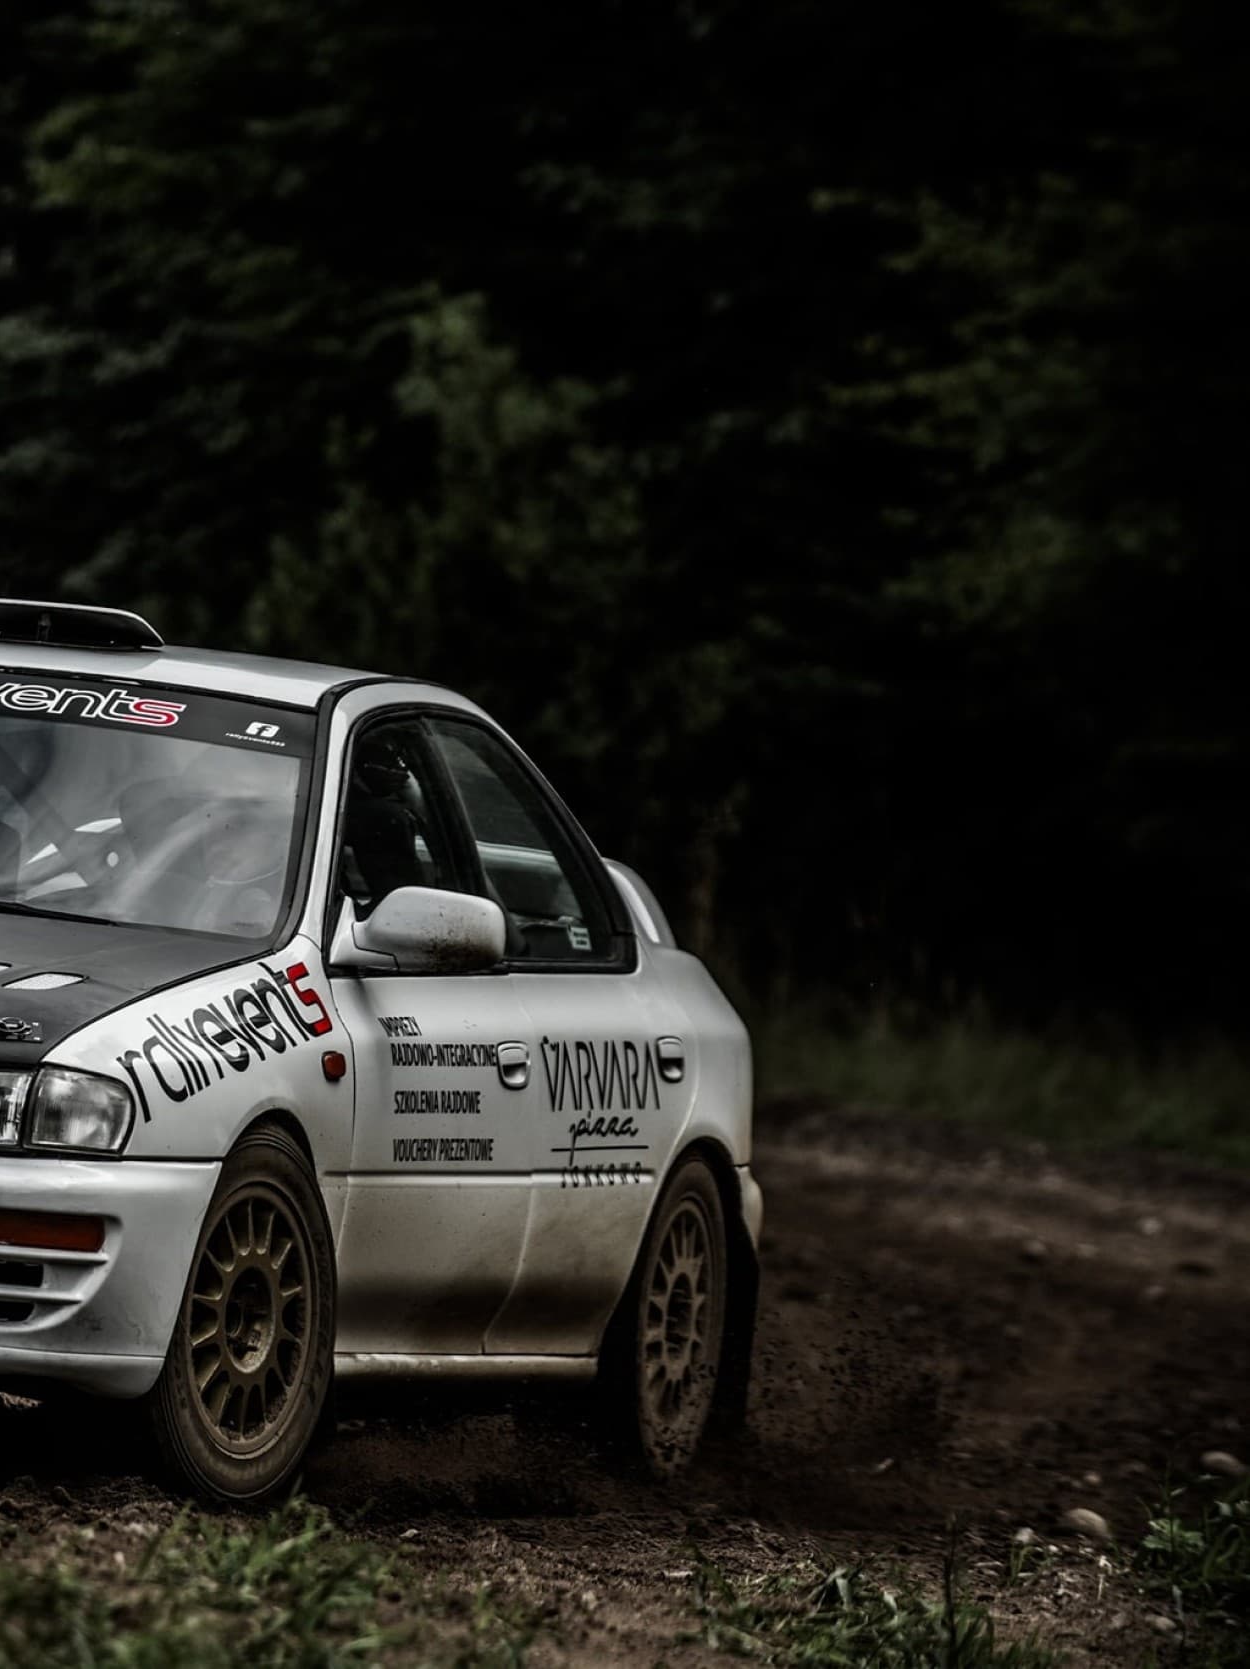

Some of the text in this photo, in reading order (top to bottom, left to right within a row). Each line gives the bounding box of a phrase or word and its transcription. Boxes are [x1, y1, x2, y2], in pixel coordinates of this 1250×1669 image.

[116, 961, 332, 1123] rallyevents
[390, 1043, 497, 1067] RAJDOWO-INTEGRACYJNE
[540, 1036, 661, 1112] VARVARA
[394, 1090, 481, 1114] SZKOLENIA RAJDOWE
[393, 1138, 494, 1162] VOUCHERY PREZENTOWE
[569, 1111, 639, 1167] pizza
